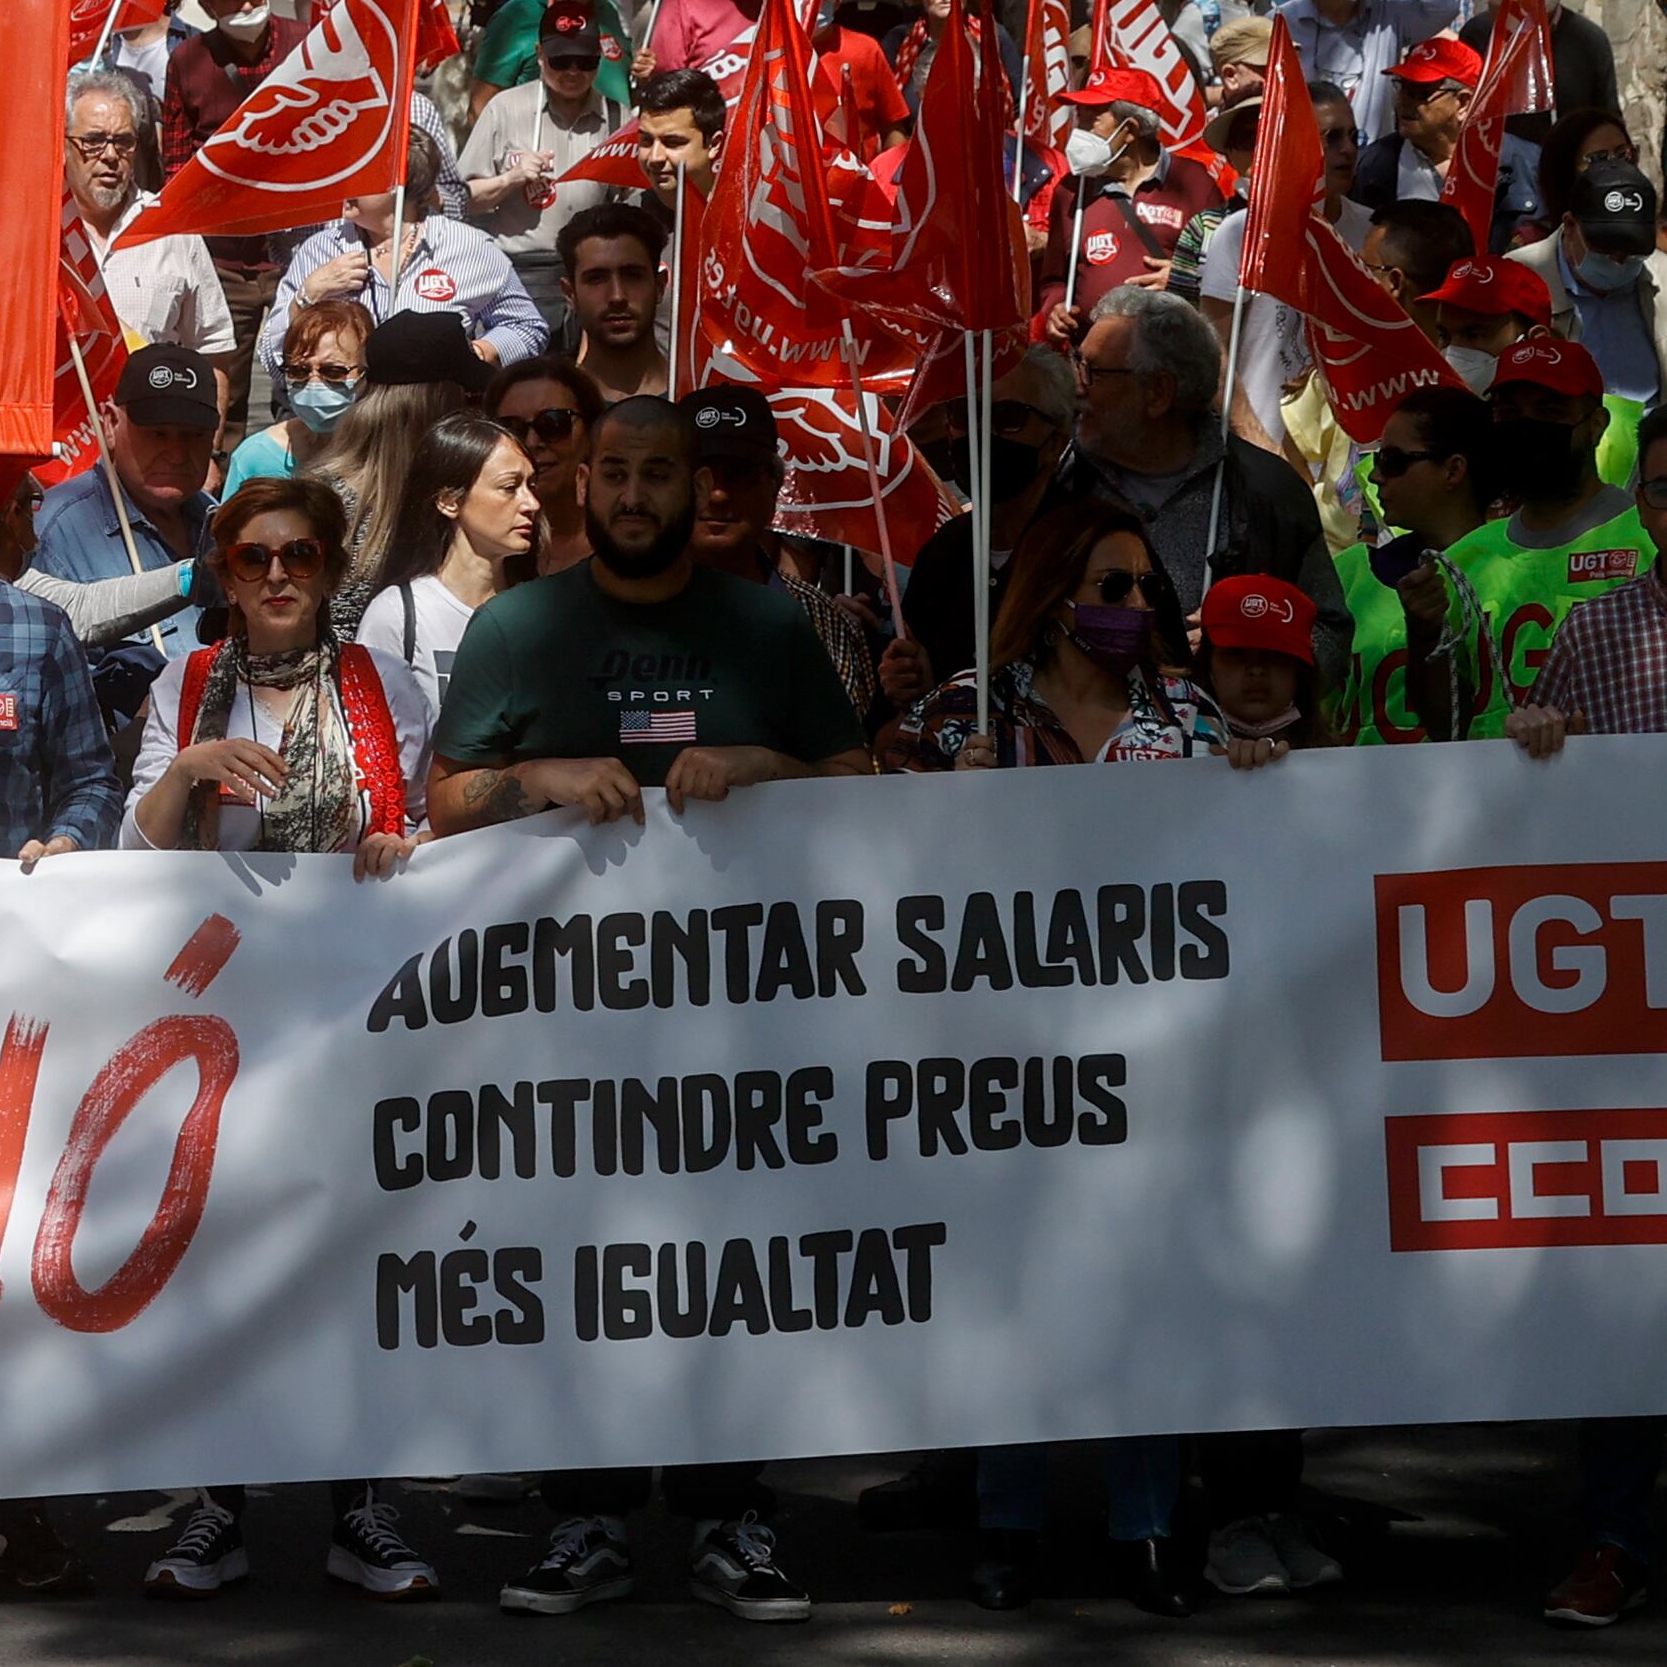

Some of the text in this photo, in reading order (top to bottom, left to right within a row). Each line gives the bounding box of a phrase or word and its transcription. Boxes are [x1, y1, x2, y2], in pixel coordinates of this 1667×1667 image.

[1087, 233, 1114, 252] UGT
[418, 274, 450, 289] UGT
[1569, 551, 1609, 572] UGT
[1074, 637, 1092, 653] UGT
[607, 689, 714, 702] SPORT
[367, 879, 1232, 1034] AUGMENTAR SALARIS
[372, 1053, 1130, 1192] CONTINDRE PREUS
[376, 1219, 948, 1352] MÉS IGUALTAT
